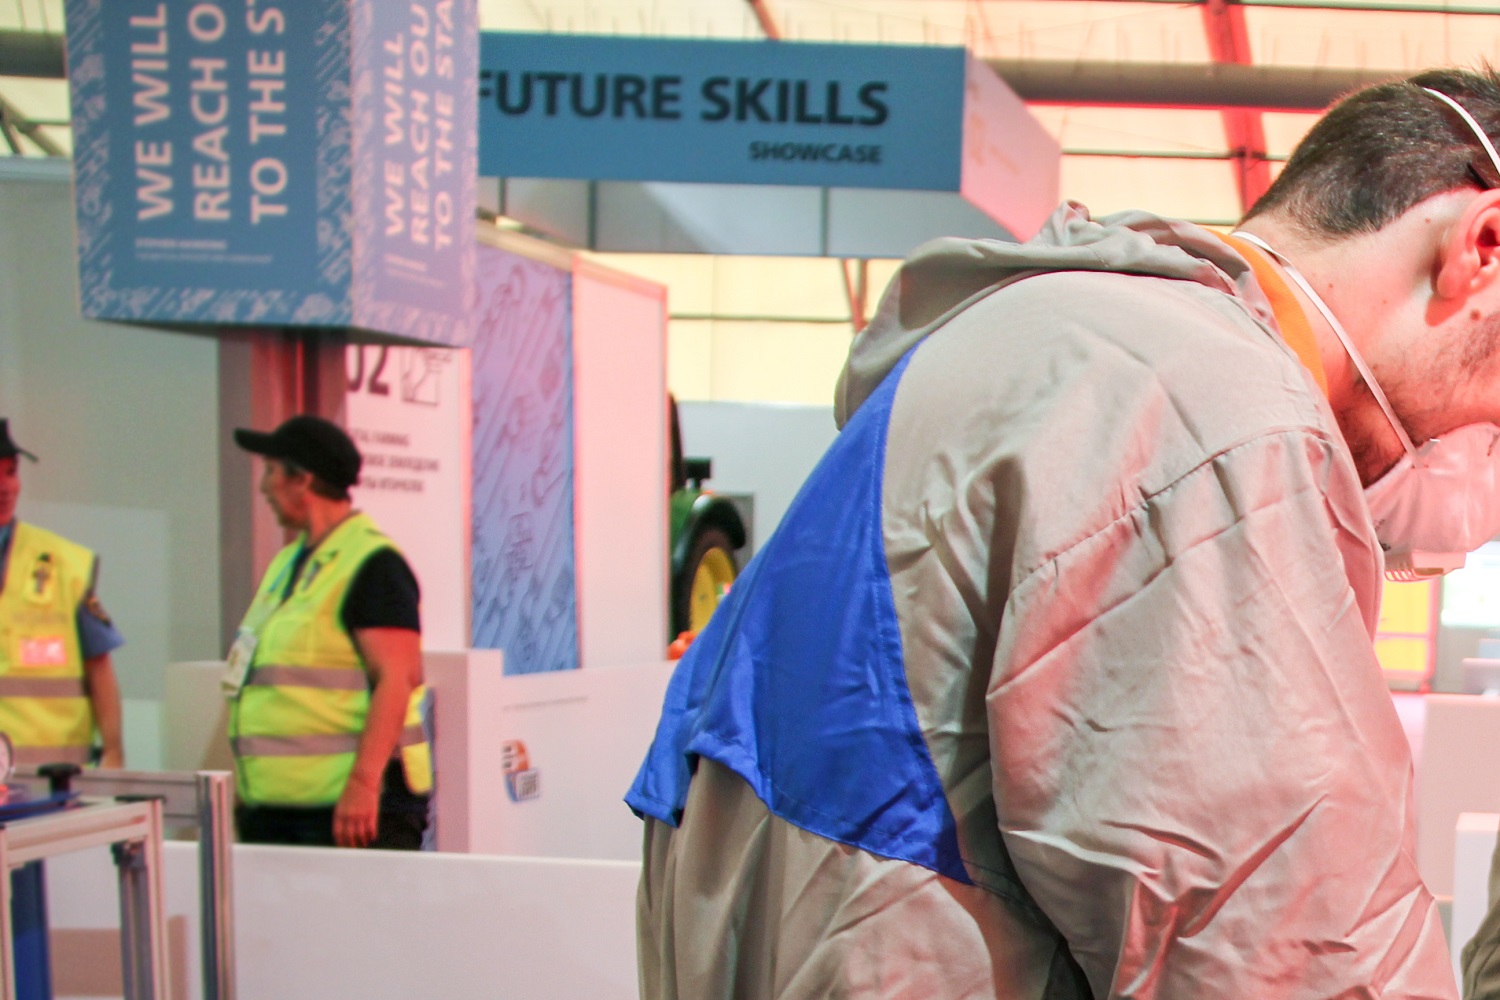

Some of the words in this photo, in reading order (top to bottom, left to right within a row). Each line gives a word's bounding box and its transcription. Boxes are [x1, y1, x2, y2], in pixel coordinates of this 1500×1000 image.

[129, 3, 170, 126] WILL
[247, 51, 286, 144] THE
[384, 31, 404, 146] WILL
[701, 76, 889, 126] SKILLS
[189, 58, 230, 220] REACH
[410, 89, 430, 244] REACH
[435, 90, 453, 177] THE
[750, 141, 882, 163] SHOWCASE
[134, 141, 173, 220] WE
[250, 157, 288, 224] TO
[384, 160, 404, 236] WE
[434, 191, 453, 252] TO
